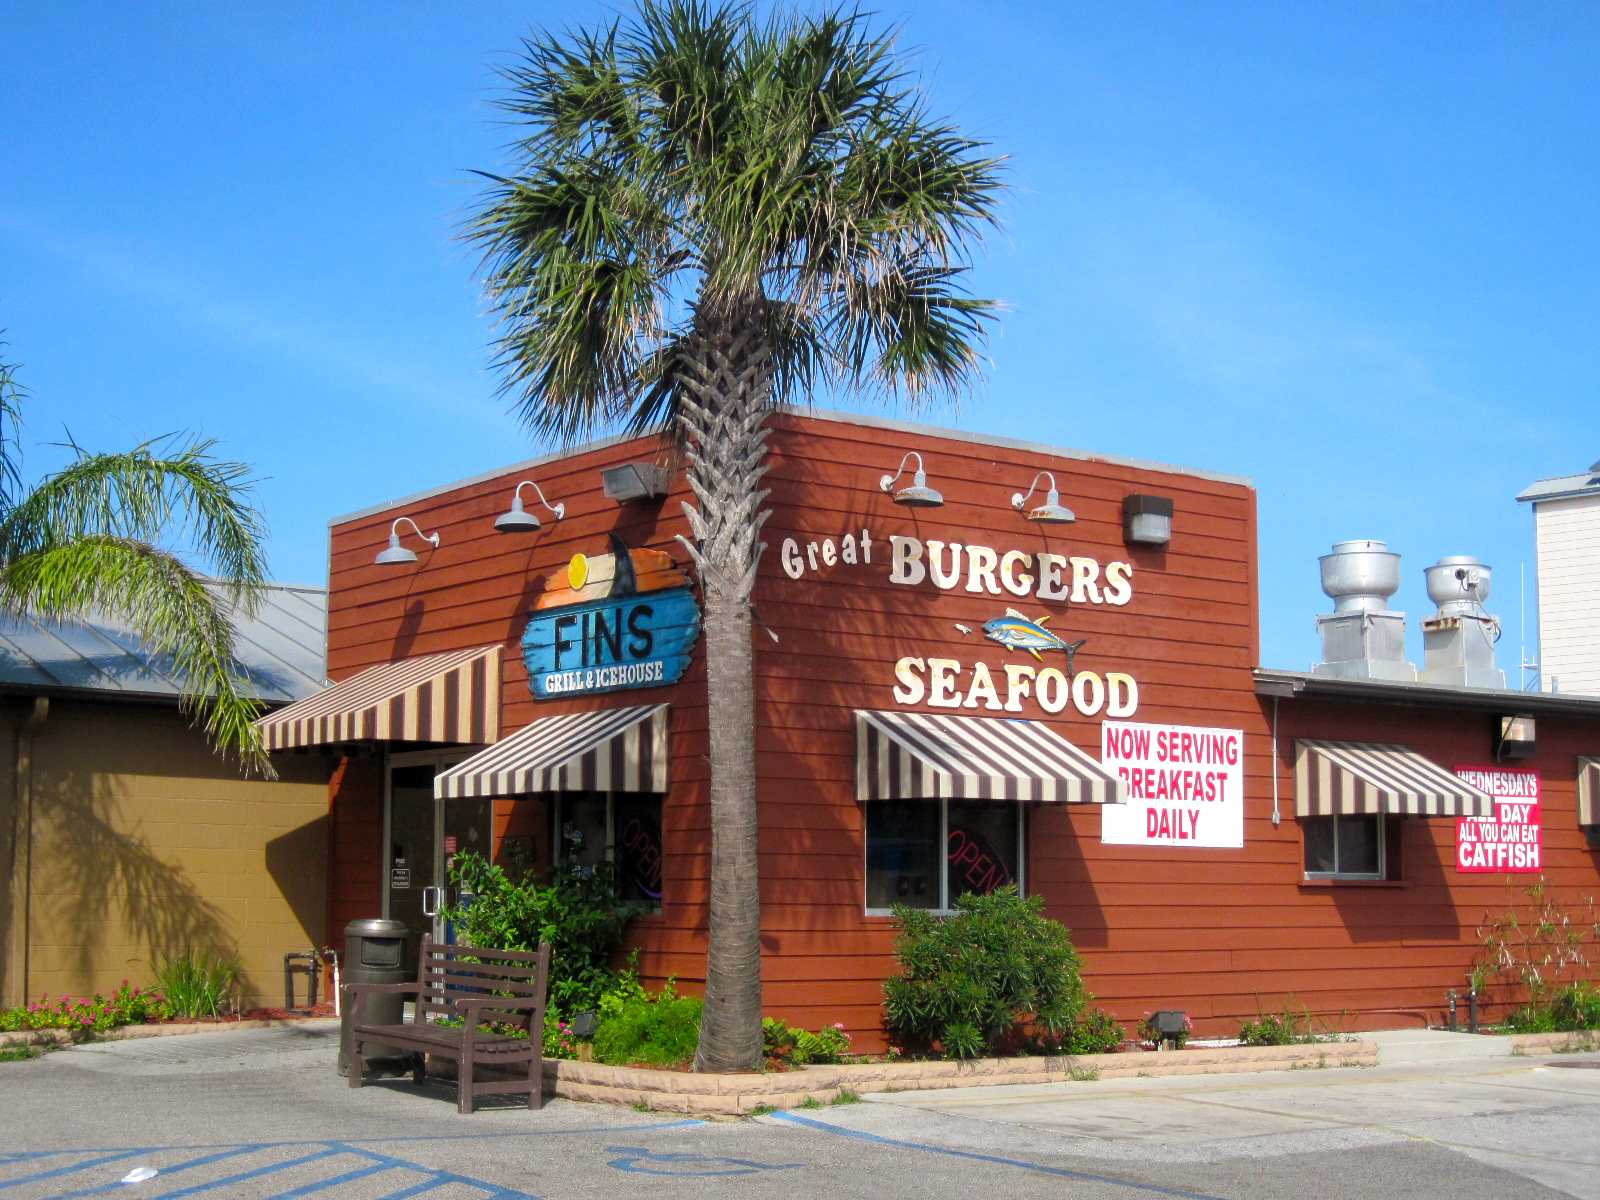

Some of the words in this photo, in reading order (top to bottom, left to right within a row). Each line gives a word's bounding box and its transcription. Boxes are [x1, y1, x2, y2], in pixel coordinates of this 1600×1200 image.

[781, 528, 872, 580] Great
[889, 535, 1132, 606] BURGERS
[554, 604, 654, 671] FINS
[545, 671, 584, 693] GRILL
[585, 672, 594, 689] &
[595, 661, 663, 688] ICEHOUSE
[893, 656, 1139, 718] SEAFOOD
[1106, 727, 1151, 761] NOW
[1156, 730, 1238, 765] SERVING
[1146, 807, 1200, 840] DAILY
[1501, 805, 1530, 823] DAY
[1459, 823, 1478, 842] ALL
[1479, 823, 1498, 843] YOU
[1501, 824, 1520, 843] CAN
[1521, 825, 1538, 843] EAT
[946, 829, 1004, 895] OPEN
[1459, 842, 1539, 868] CATFISH
